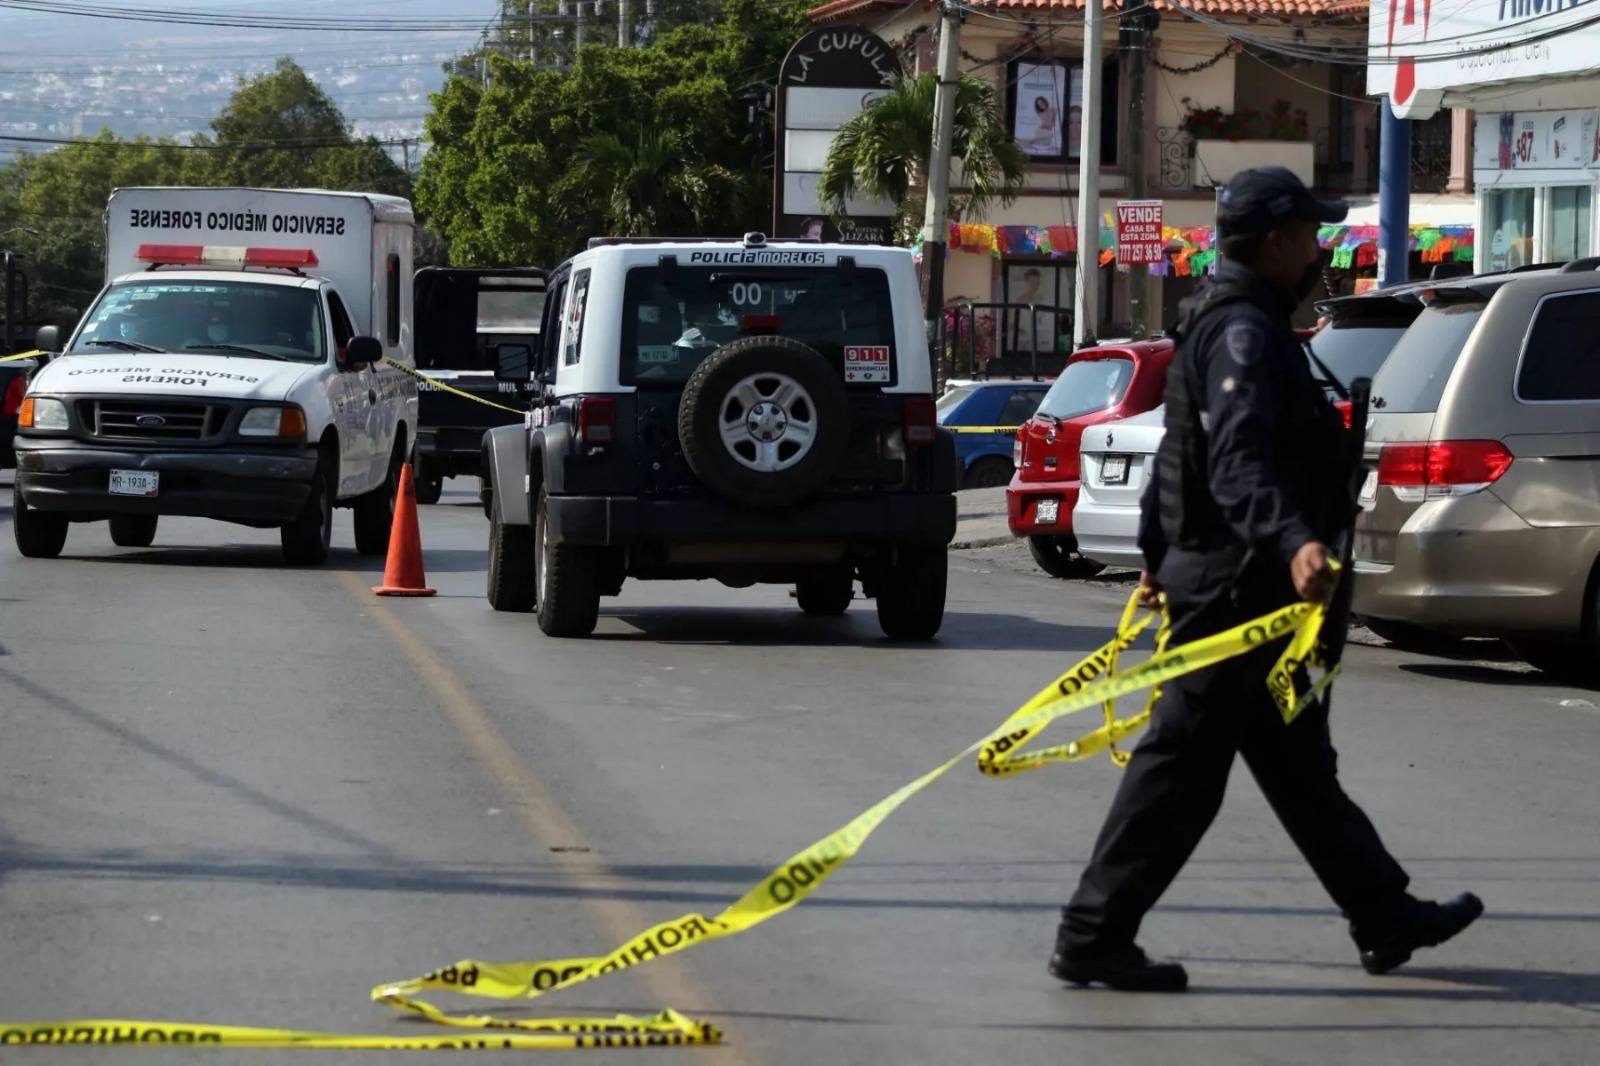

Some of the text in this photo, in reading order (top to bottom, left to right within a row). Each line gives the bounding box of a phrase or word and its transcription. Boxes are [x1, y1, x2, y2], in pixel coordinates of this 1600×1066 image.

[789, 54, 814, 83] LA
[1119, 207, 1161, 223] VENDE
[1125, 224, 1156, 232] CASA EN
[1120, 233, 1160, 241] ESTA ZONA
[1119, 244, 1131, 262] 777
[848, 349, 885, 361] 911
